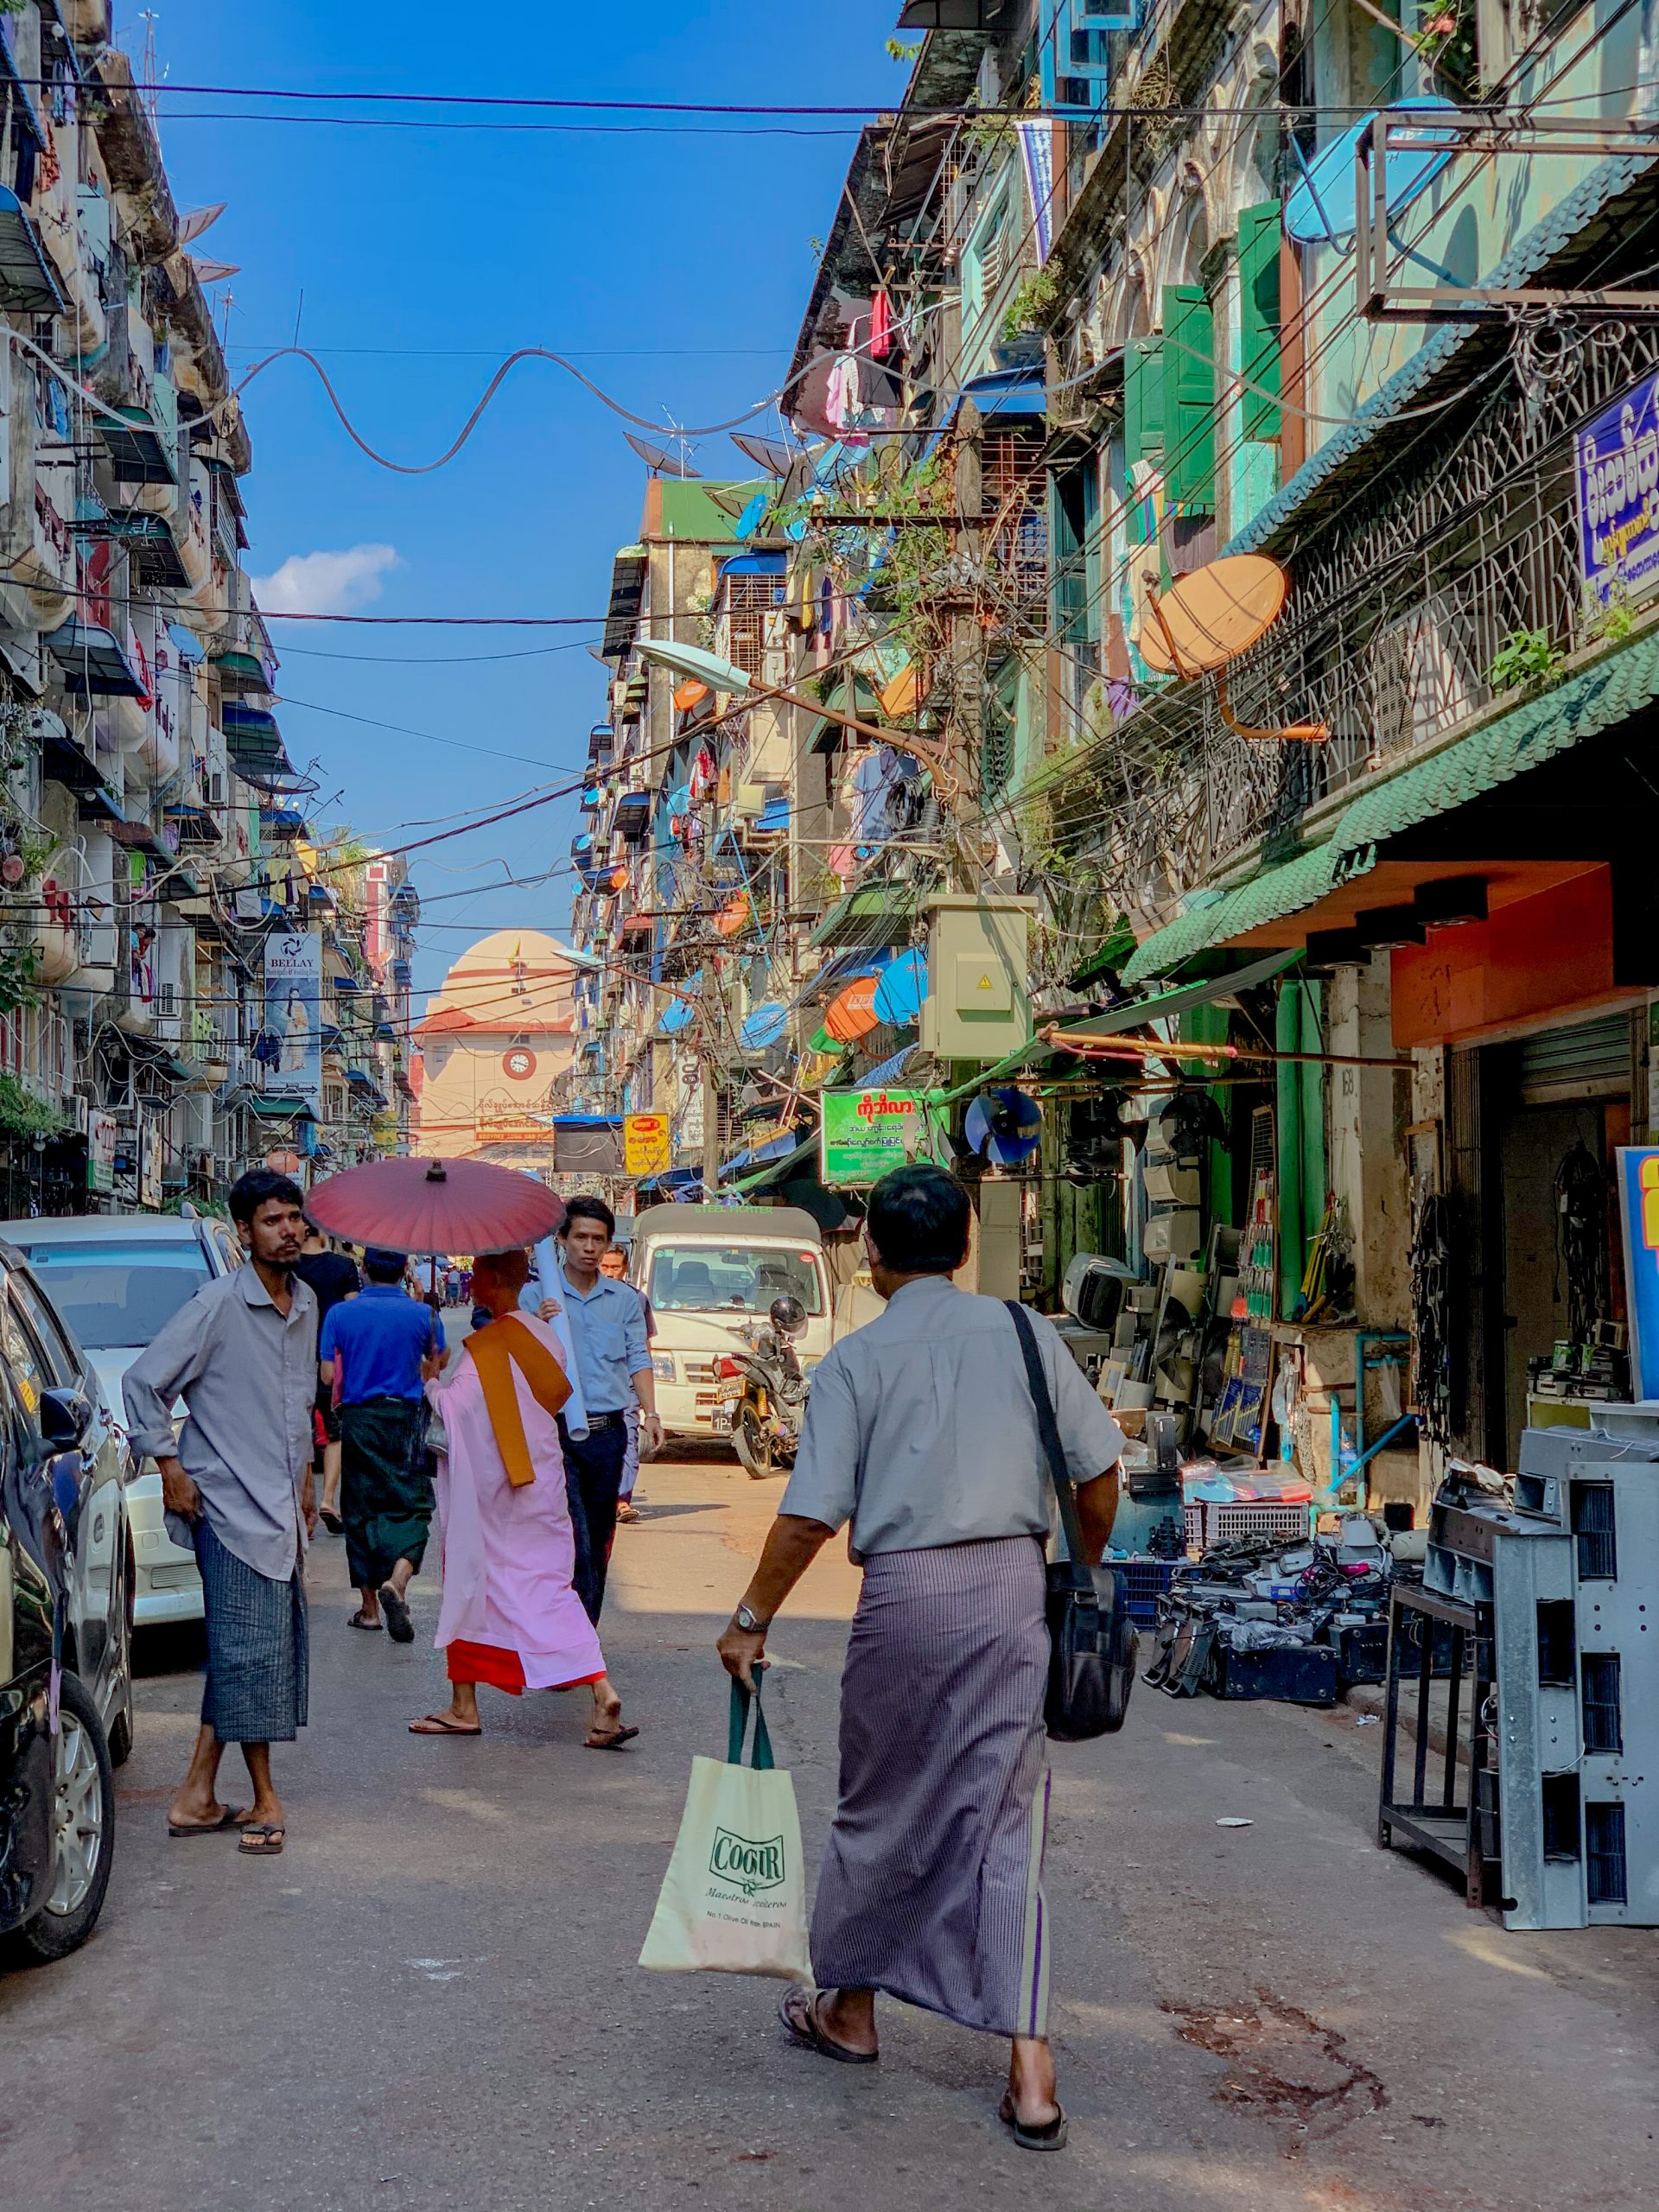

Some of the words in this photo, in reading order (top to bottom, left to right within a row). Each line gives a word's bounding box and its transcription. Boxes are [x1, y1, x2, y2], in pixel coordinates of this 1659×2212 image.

[271, 959, 314, 968] BELLAY
[694, 1205, 726, 1213] STEEL
[729, 1205, 773, 1215] FIGHTER
[705, 1887, 749, 1904] Maestros
[723, 1914, 739, 1923] Olive
